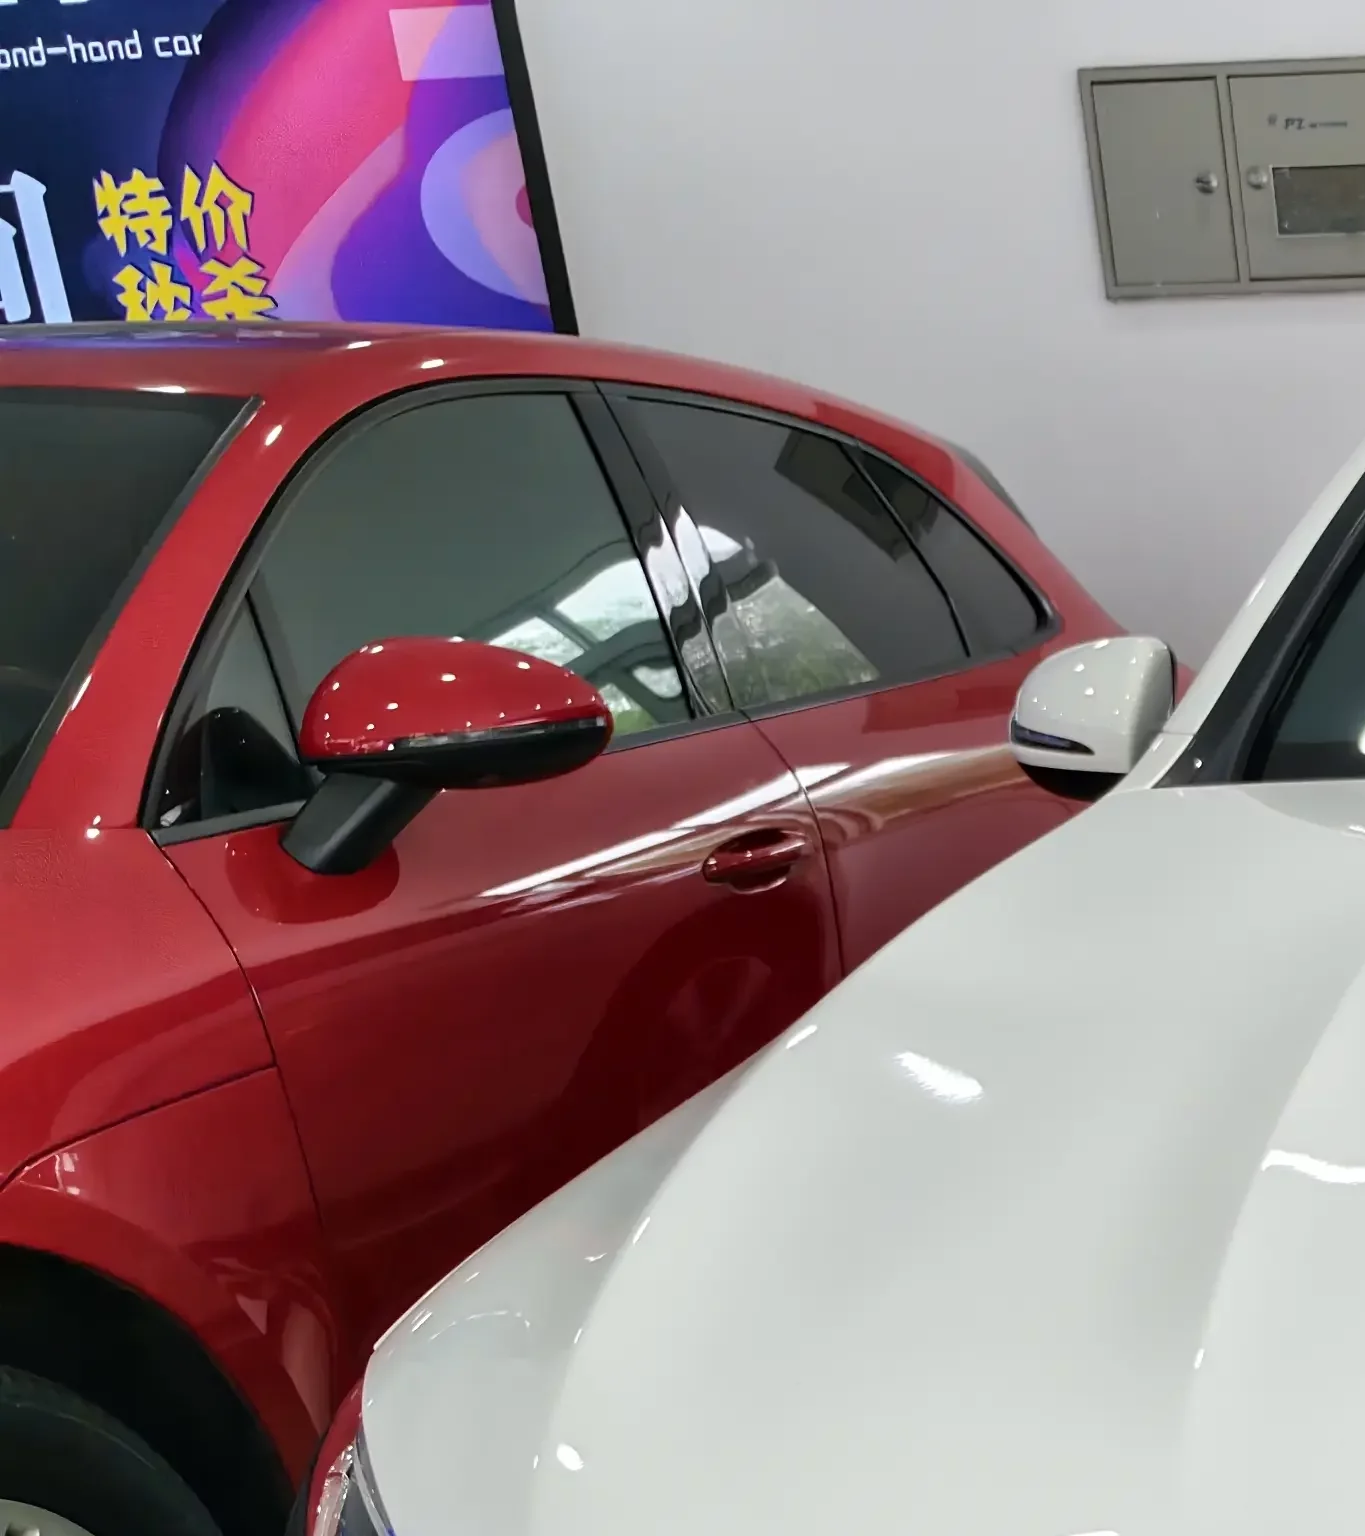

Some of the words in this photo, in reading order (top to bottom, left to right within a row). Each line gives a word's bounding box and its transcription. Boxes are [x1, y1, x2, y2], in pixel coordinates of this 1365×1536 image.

[153, 33, 203, 59] car
[92, 160, 254, 258] 特价
[112, 255, 278, 323] 秒杀
